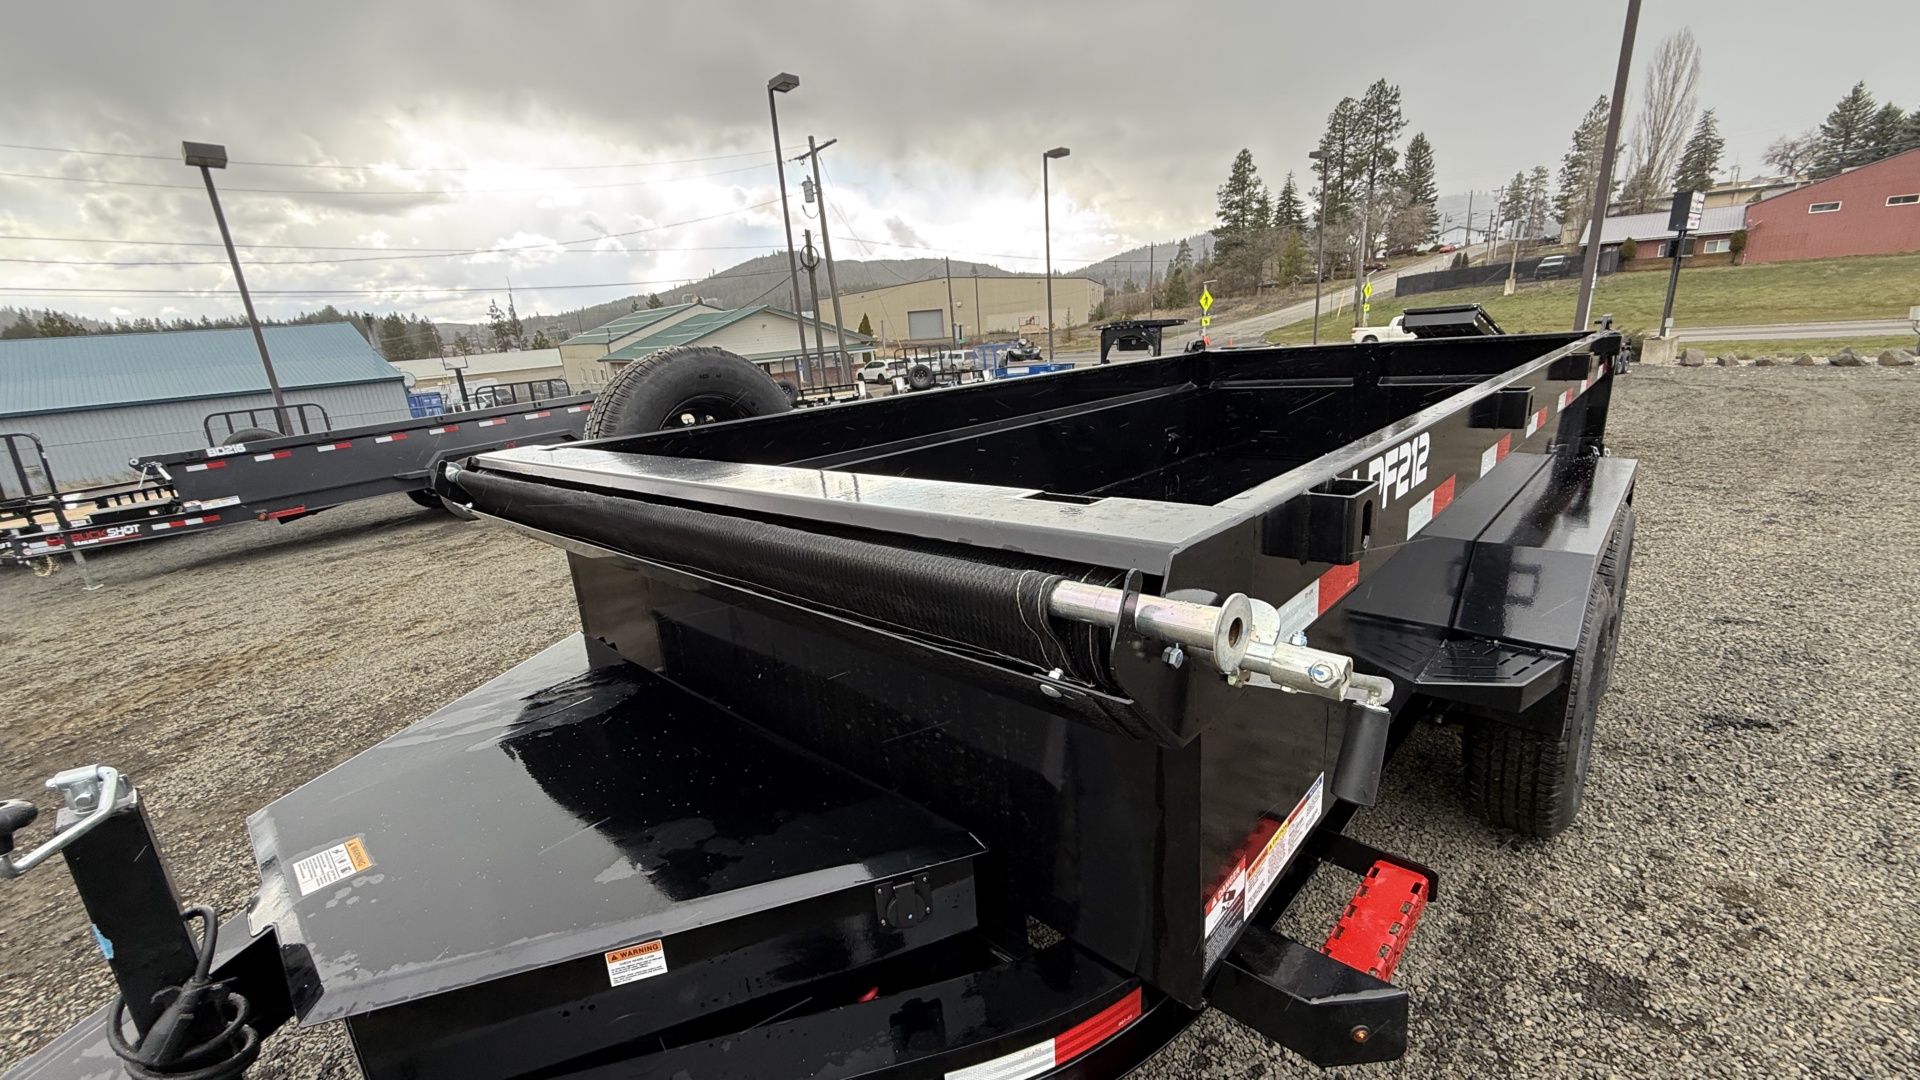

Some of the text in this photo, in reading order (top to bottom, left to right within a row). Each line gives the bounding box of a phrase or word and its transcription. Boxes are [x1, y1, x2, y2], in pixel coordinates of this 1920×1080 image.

[206, 443, 246, 457] BD216
[1218, 866, 1240, 900] DANGER
[620, 944, 659, 958] WARNING
